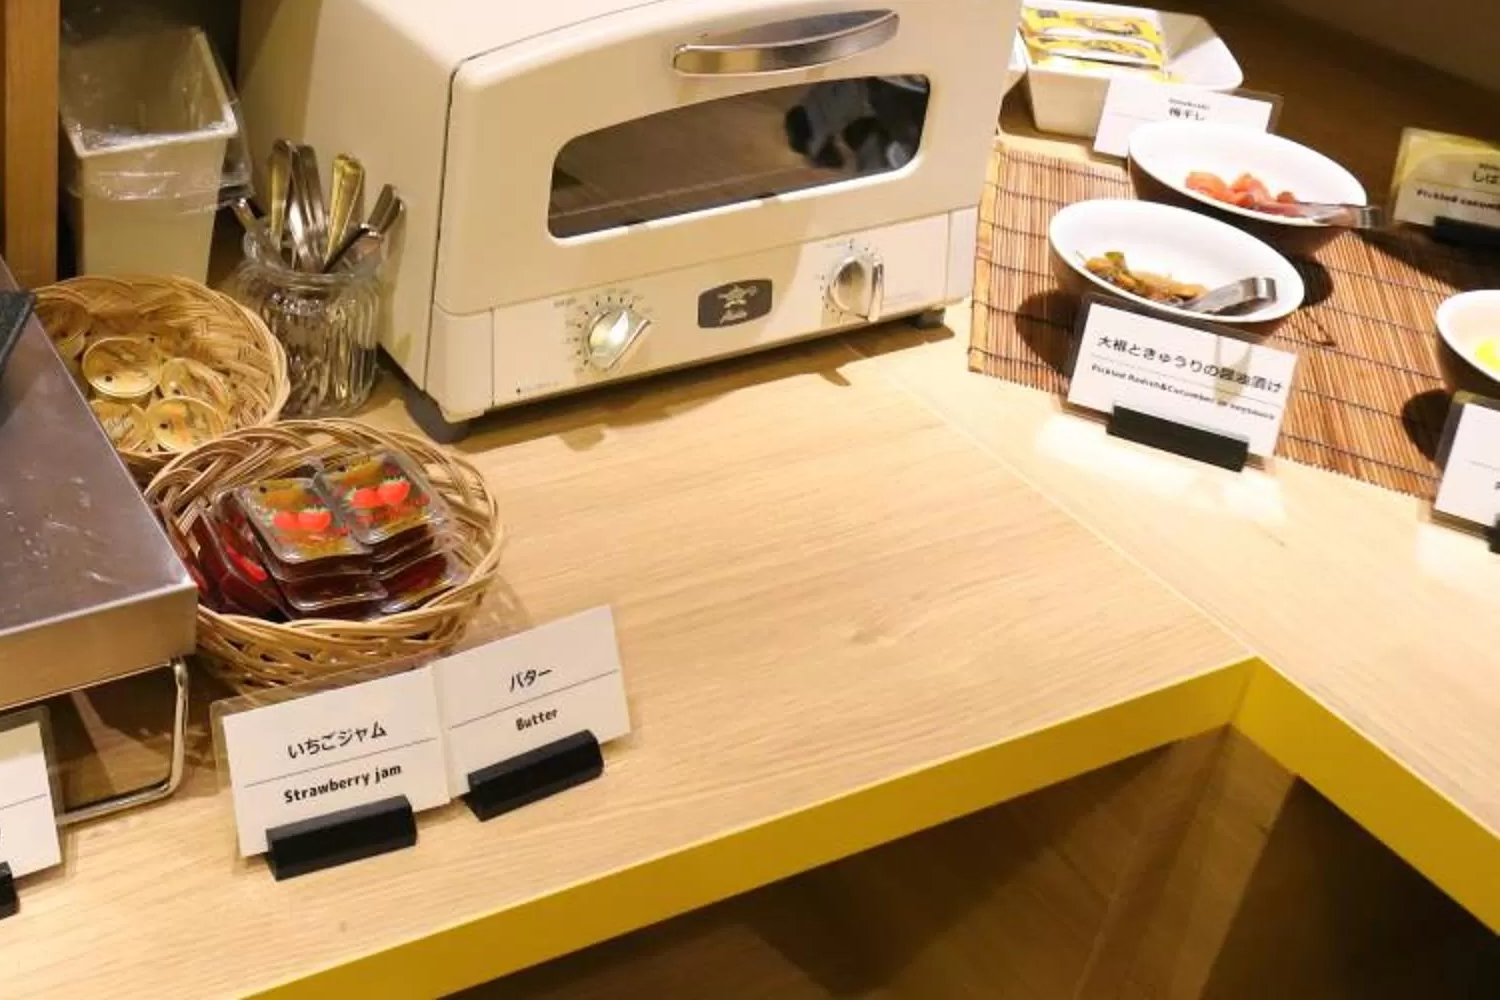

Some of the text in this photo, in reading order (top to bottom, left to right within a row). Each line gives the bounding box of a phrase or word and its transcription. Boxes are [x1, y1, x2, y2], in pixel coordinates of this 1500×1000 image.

[509, 669, 553, 693] バター
[515, 709, 558, 731] Butter
[287, 721, 388, 759] いちごジャム
[283, 765, 402, 803] Strawberry jam
